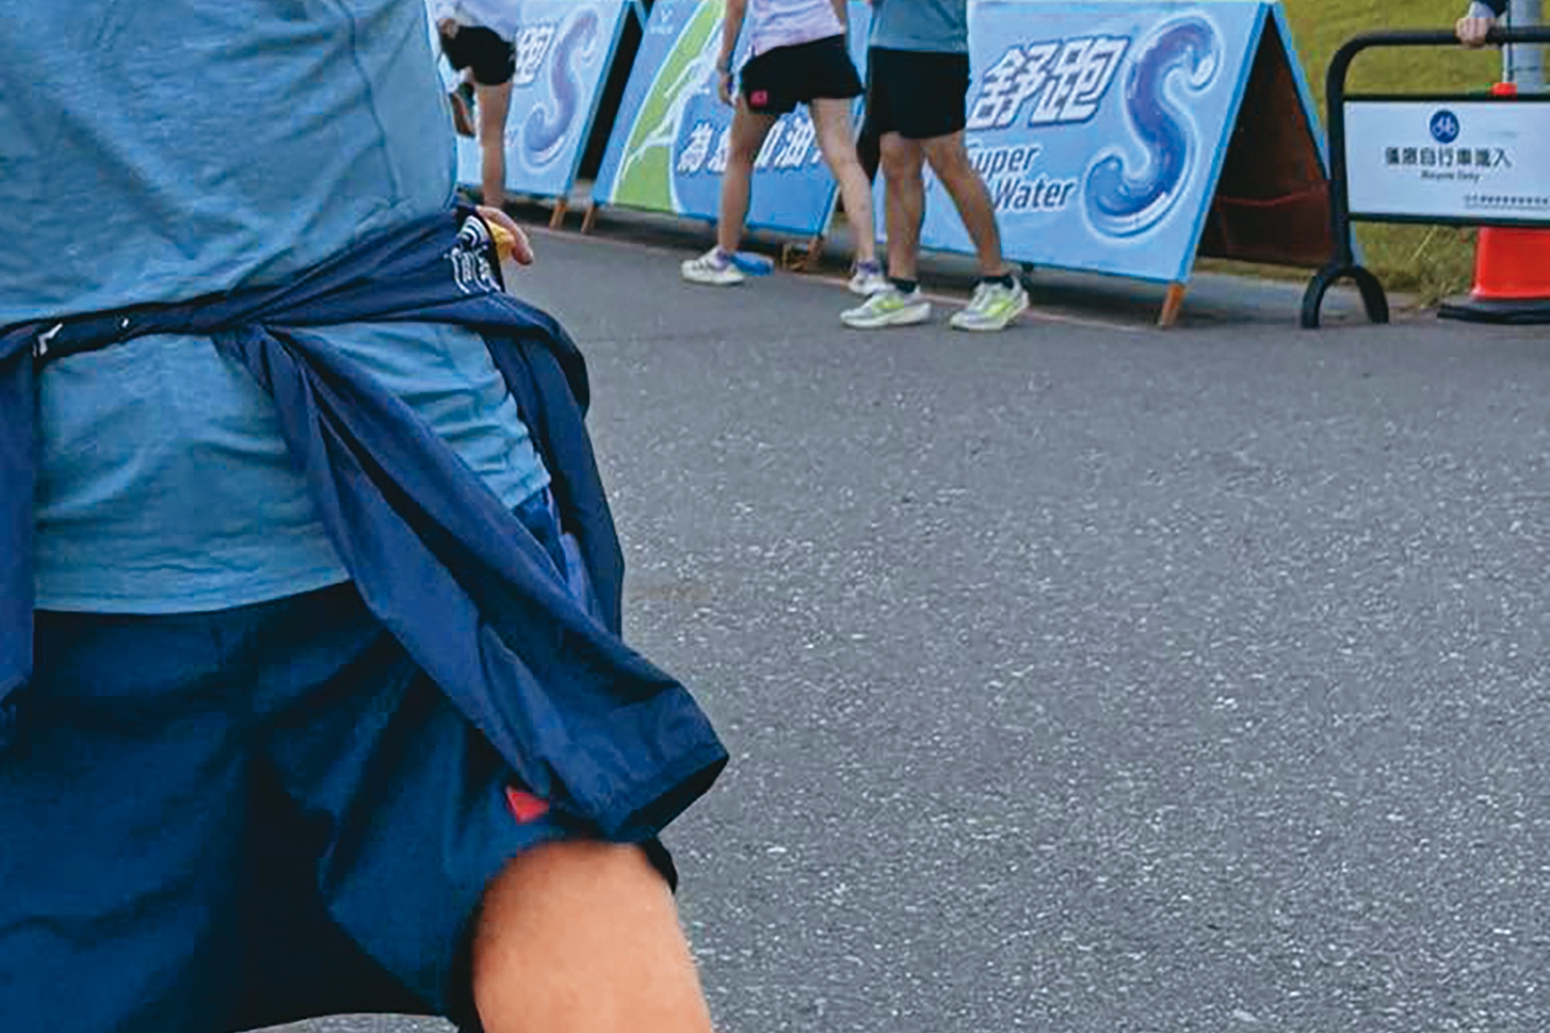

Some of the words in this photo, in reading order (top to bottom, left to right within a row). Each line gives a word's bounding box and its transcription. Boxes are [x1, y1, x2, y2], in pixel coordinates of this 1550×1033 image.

[964, 33, 1132, 132] 舒跑
[968, 142, 1039, 181] Super
[993, 178, 1075, 213] Water
